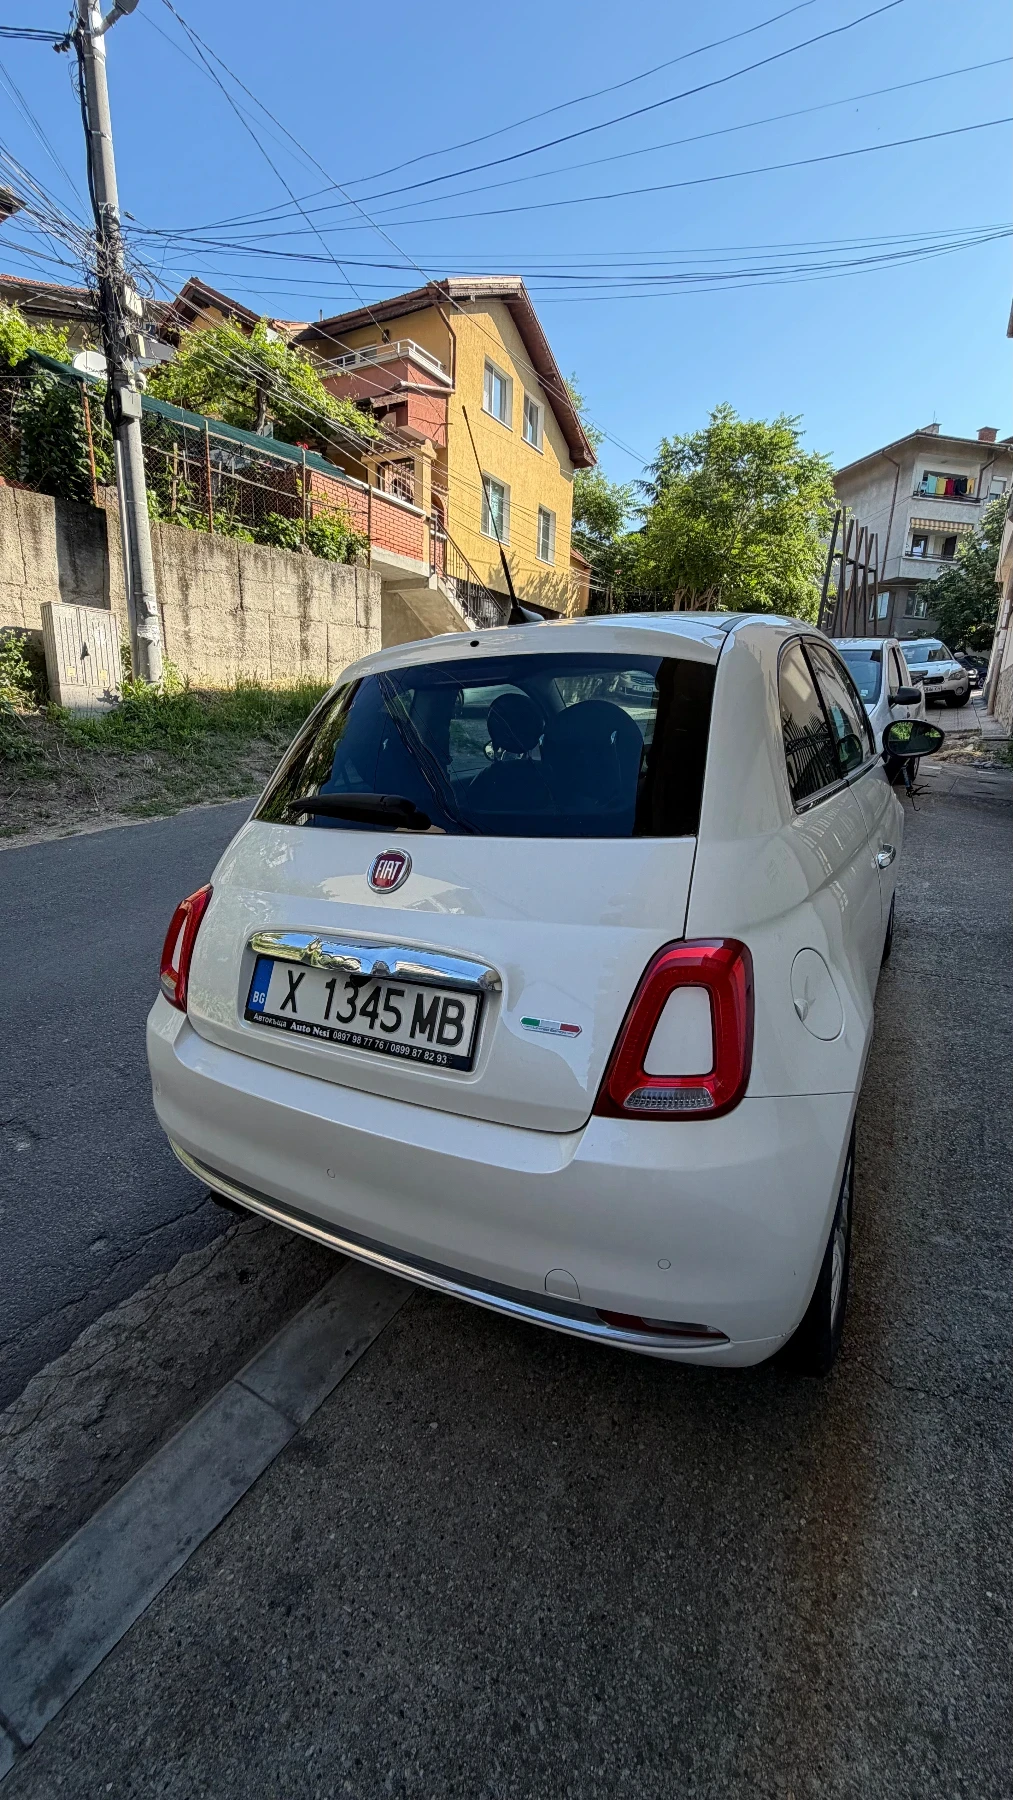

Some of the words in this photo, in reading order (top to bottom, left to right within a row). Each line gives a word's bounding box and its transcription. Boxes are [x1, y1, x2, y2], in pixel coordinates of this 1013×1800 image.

[374, 859, 403, 881] FIAT
[252, 990, 266, 1005] BG
[279, 969, 306, 1014] X
[323, 977, 406, 1033] 1345
[409, 993, 466, 1048] MB
[253, 1012, 287, 1028] Автокъща
[290, 1021, 311, 1033] Auto
[312, 1026, 331, 1038] Nesi
[332, 1031, 351, 1041] 0897
[352, 1034, 362, 1044] 98
[363, 1037, 373, 1047] 77
[374, 1039, 384, 1050] 76
[390, 1043, 410, 1055] 0899
[412, 1048, 423, 1058] 87
[424, 1050, 435, 1061] 82
[436, 1053, 448, 1064] 93
